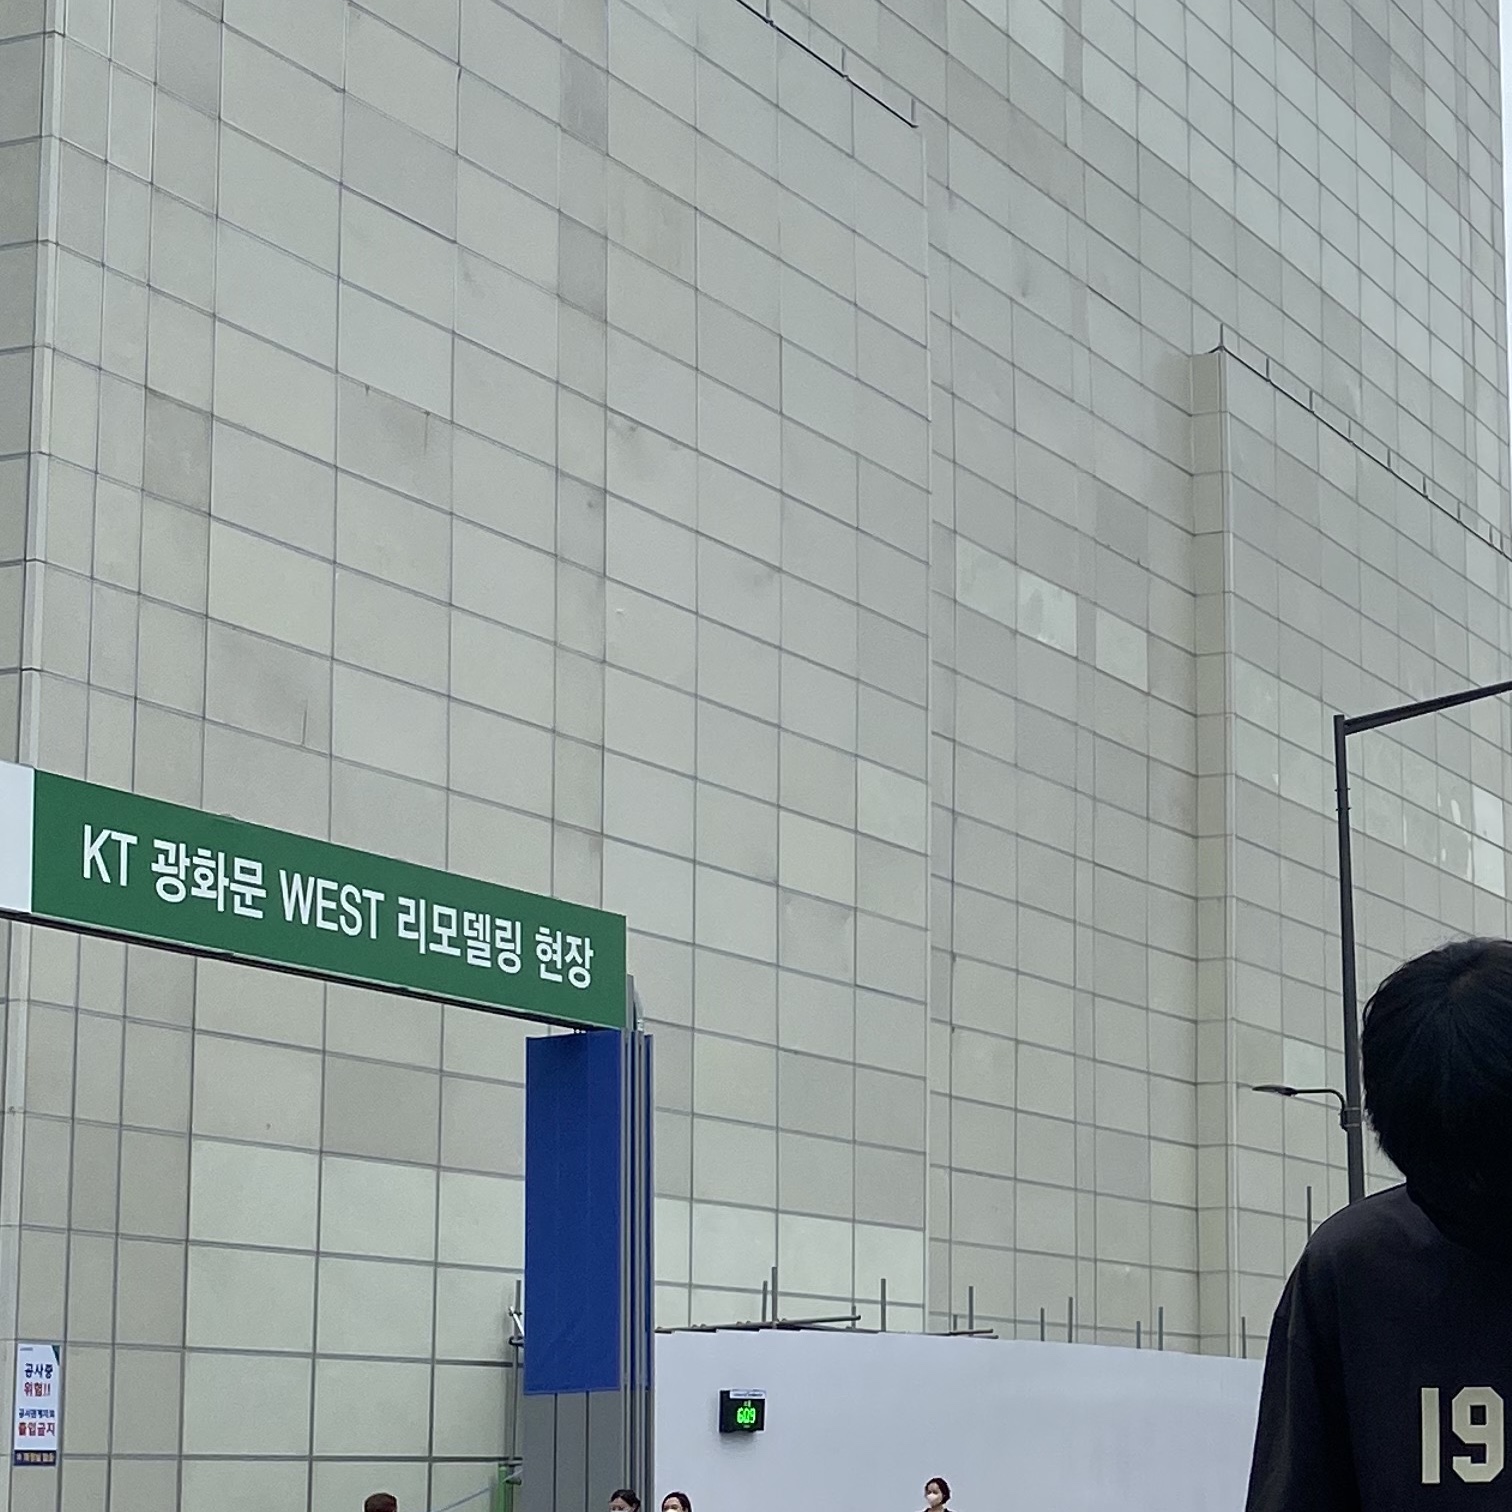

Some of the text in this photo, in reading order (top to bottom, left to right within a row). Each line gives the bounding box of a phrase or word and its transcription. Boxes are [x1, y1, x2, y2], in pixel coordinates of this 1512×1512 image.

[83, 825, 594, 989] KT 광화문 WEST 리모델링 현장
[25, 1363, 53, 1379] 공사중
[19, 1422, 55, 1436] 출입금지
